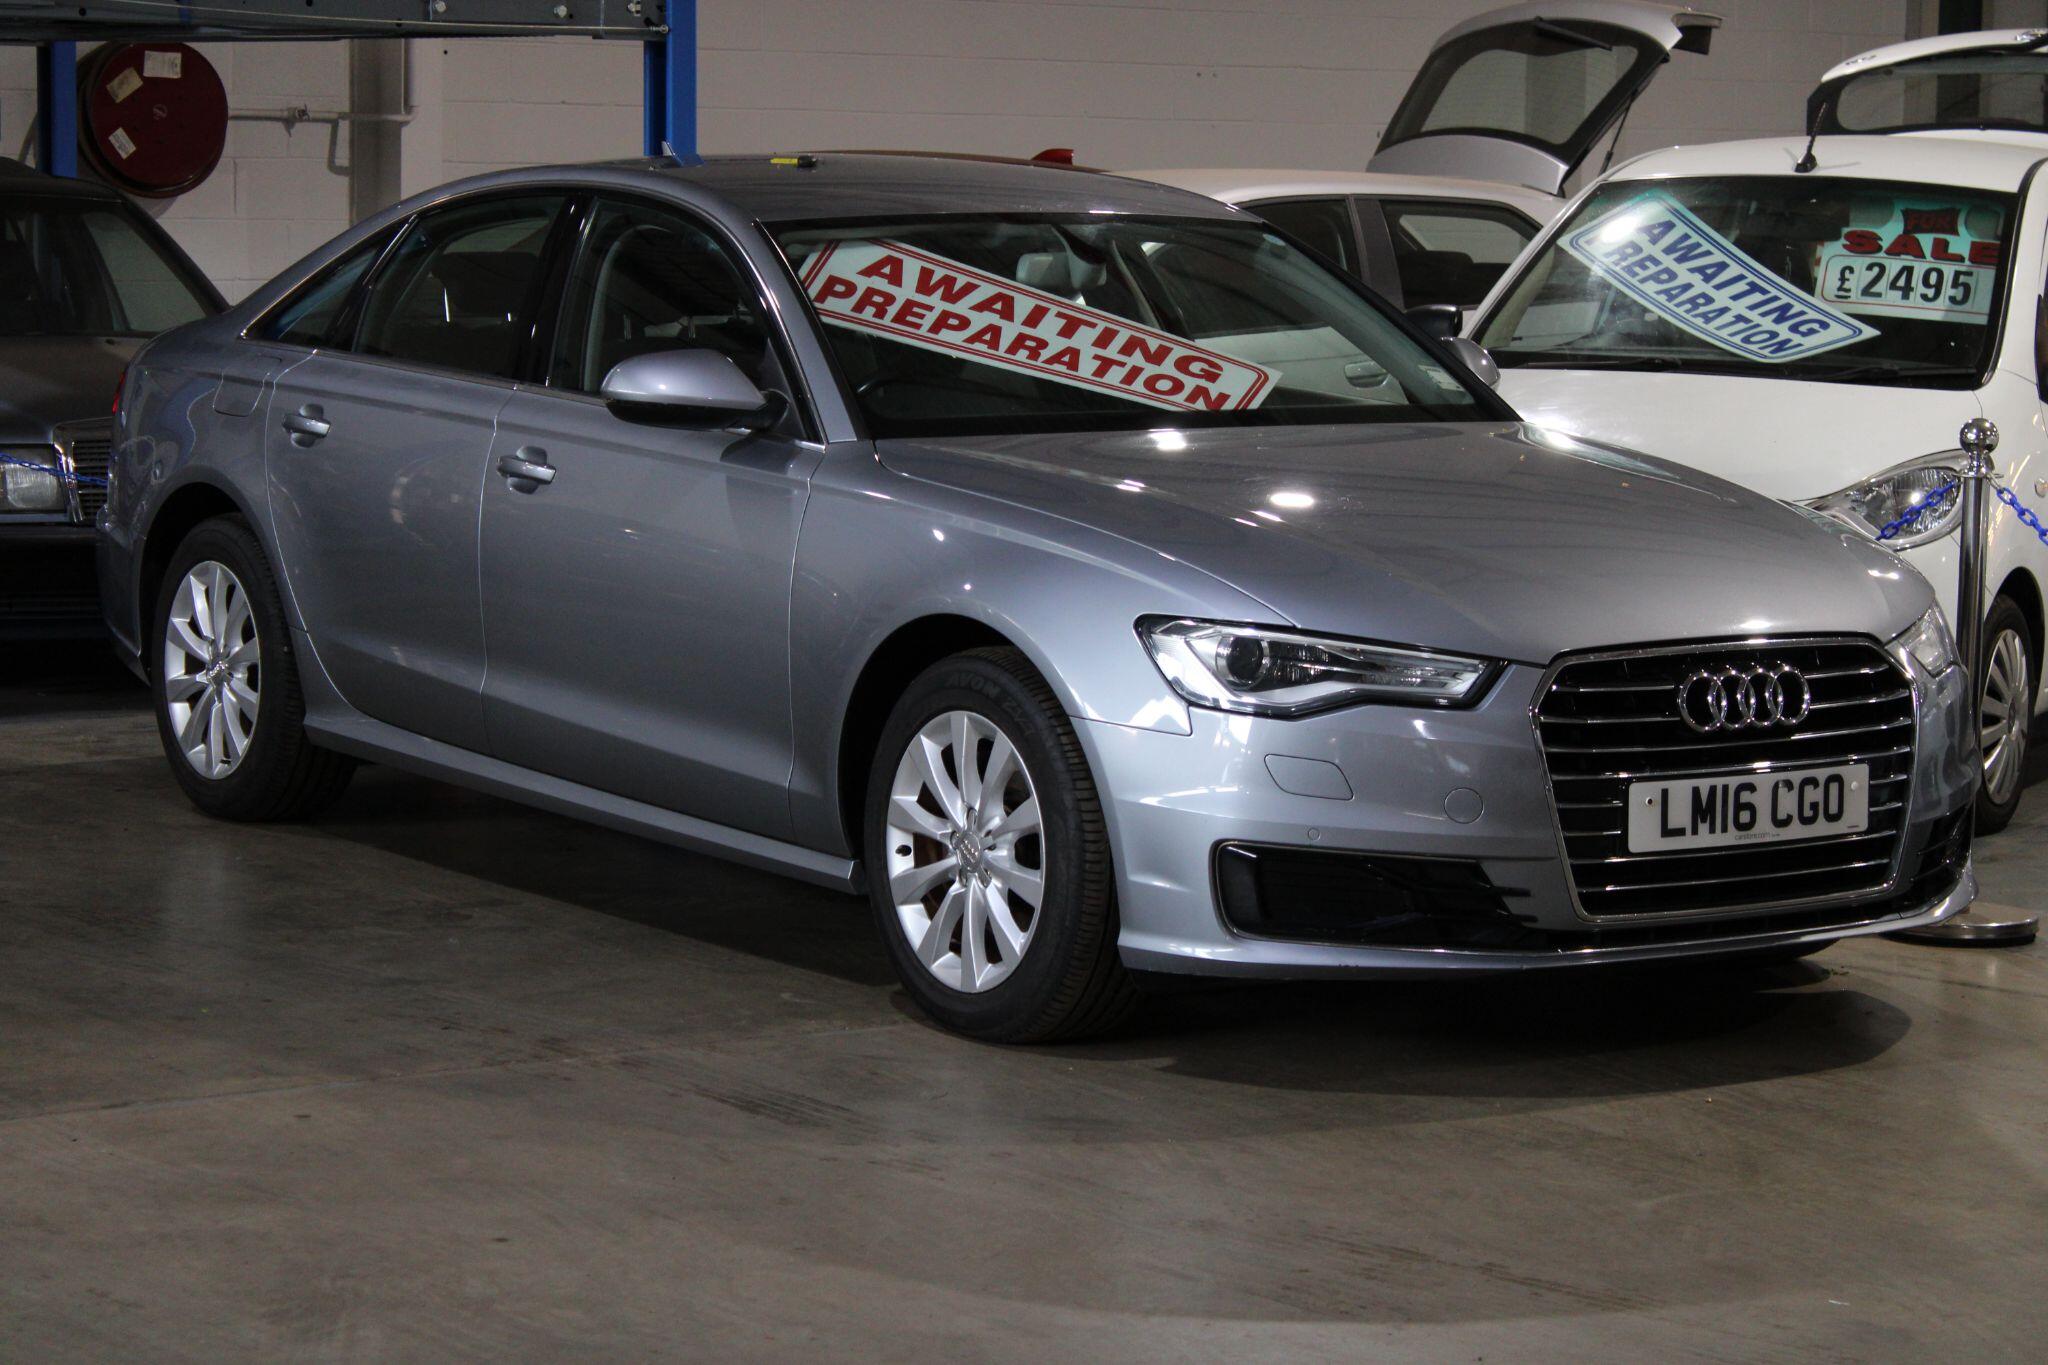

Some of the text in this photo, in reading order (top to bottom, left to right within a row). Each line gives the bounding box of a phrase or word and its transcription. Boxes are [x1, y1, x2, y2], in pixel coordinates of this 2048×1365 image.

[1842, 230, 2001, 264] SALE
[1907, 211, 1953, 232] FOR
[1636, 219, 1831, 338] AWAITING
[1834, 261, 1974, 306] £2495
[812, 274, 1231, 410] PREPARATION
[856, 254, 1223, 384] AWAITING
[1660, 773, 1845, 839] LM16 CGO
